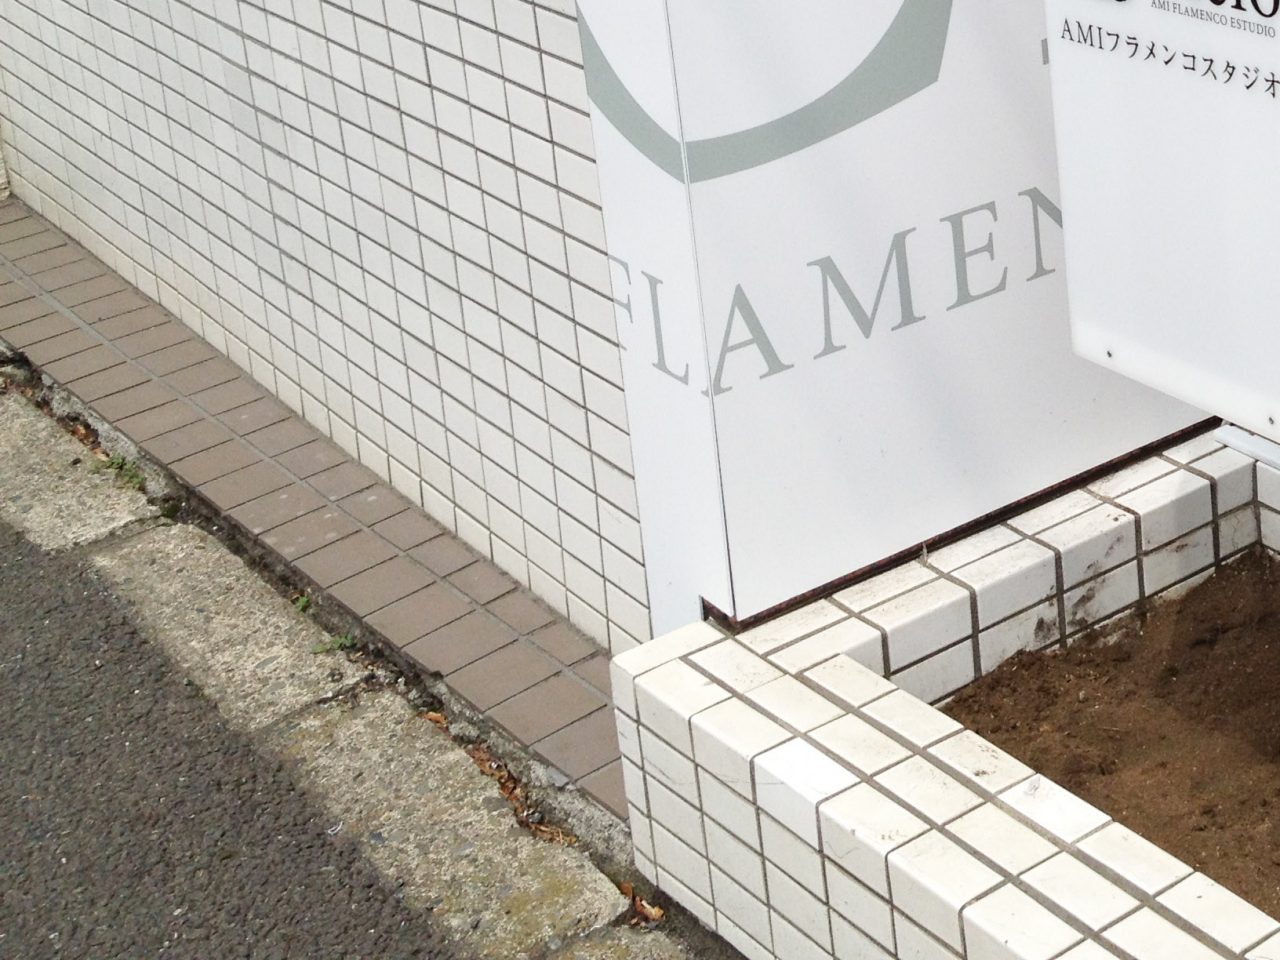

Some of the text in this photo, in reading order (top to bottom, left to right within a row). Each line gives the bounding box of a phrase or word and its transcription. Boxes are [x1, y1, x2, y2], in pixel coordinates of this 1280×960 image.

[1172, 2, 1228, 27] FLAMENCO
[1230, 16, 1276, 38] ESTUDIO
[1061, 17, 1280, 99] AMIフラメンコスタジオ
